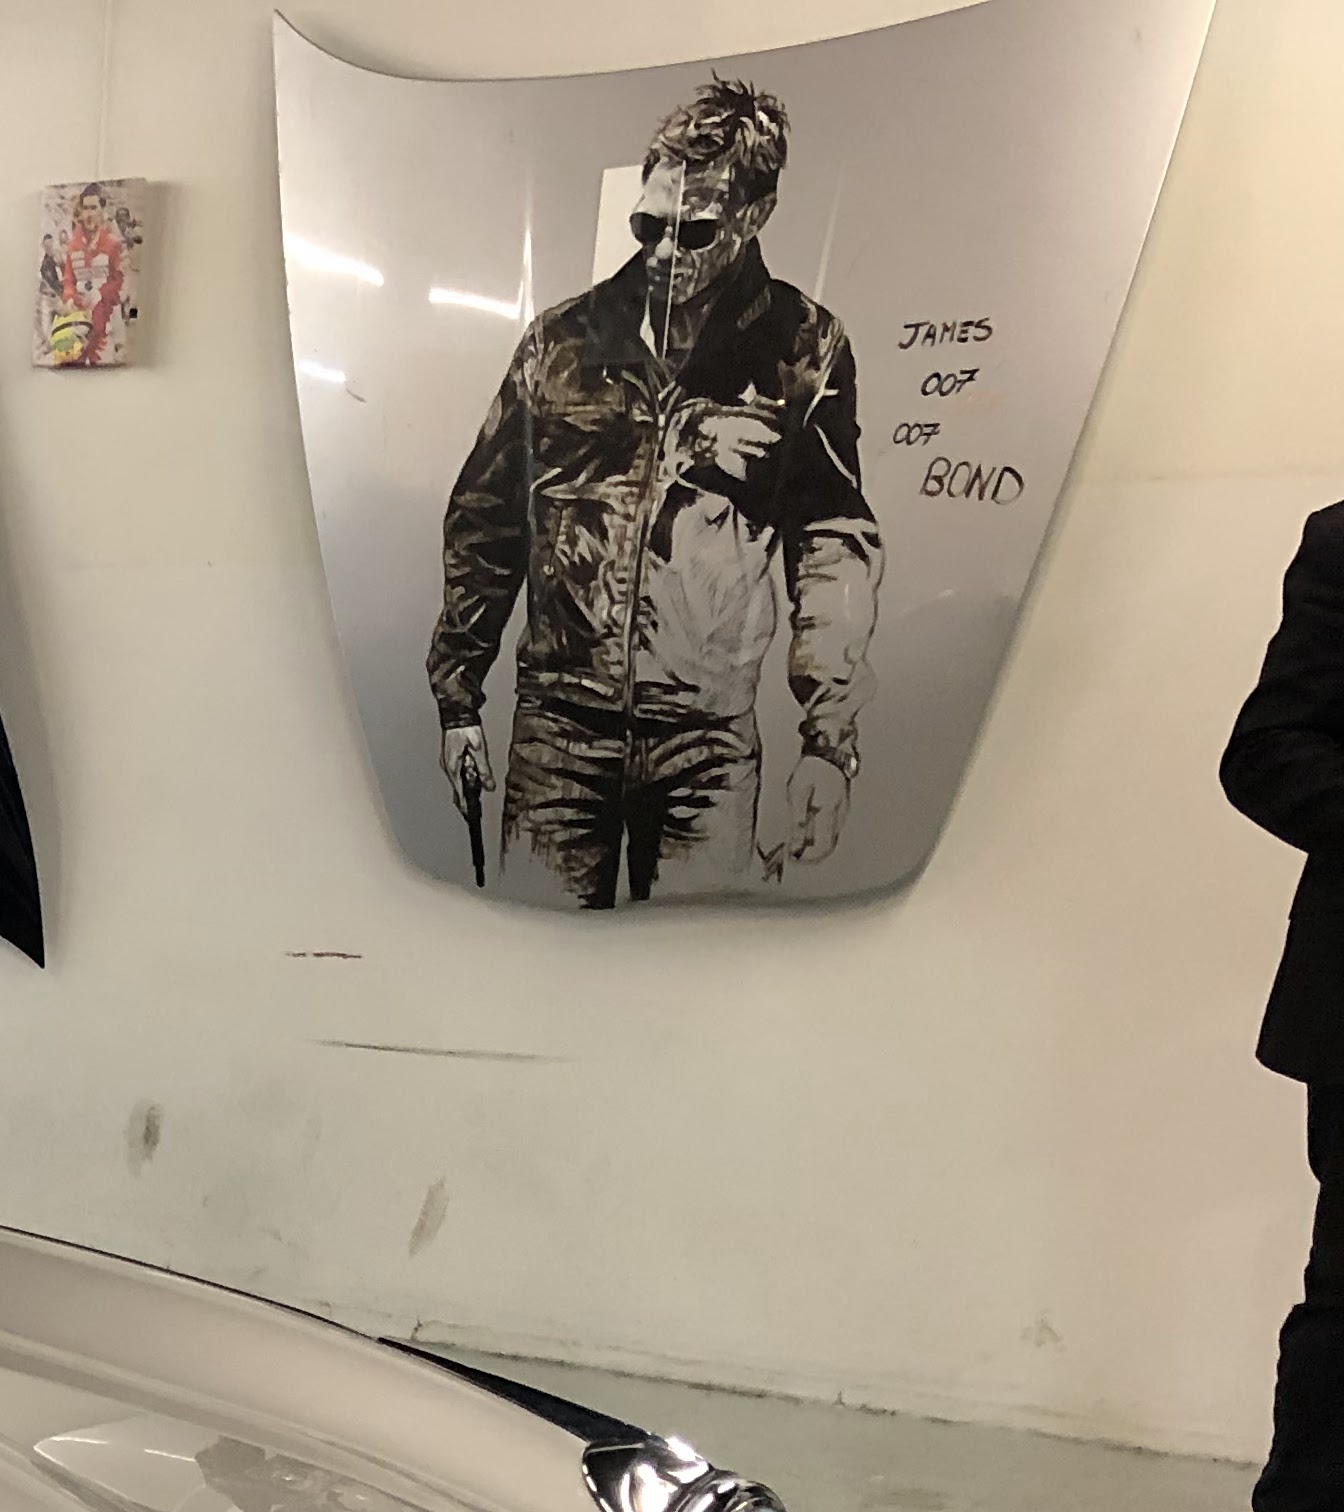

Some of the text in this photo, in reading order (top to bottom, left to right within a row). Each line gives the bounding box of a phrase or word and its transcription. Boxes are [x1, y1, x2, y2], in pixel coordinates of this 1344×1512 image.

[898, 317, 993, 350] JAMES
[920, 368, 980, 397] 007
[892, 422, 941, 446] 007
[919, 456, 1025, 504] BOND
